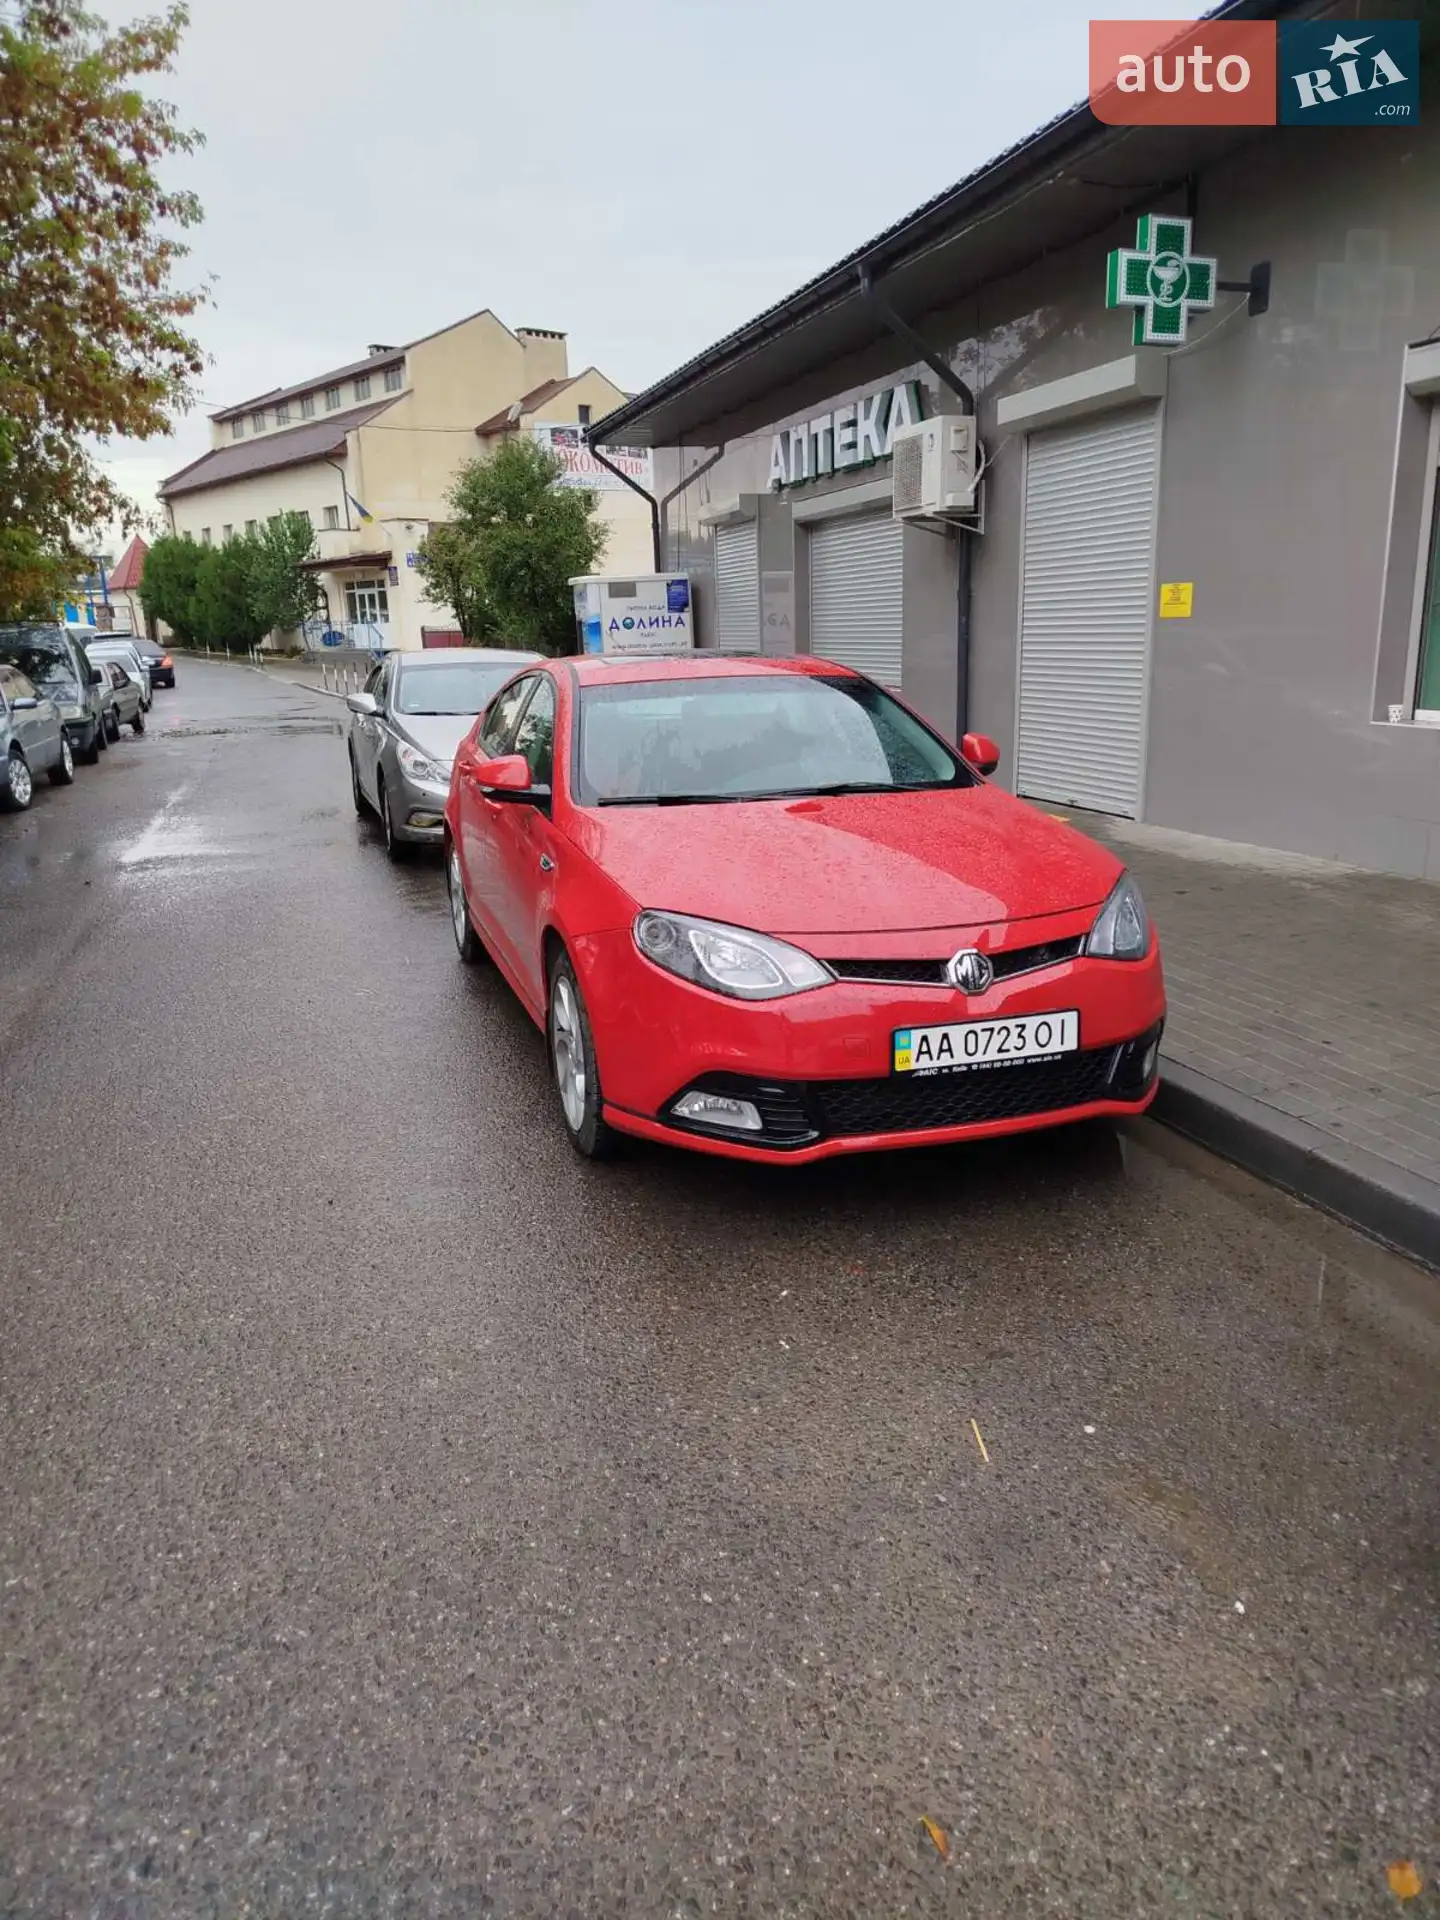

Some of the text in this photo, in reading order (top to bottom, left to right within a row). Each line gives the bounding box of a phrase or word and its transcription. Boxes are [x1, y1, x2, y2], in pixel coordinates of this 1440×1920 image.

[766, 382, 918, 490] АПТЕКА
[609, 615, 685, 632] ДОЛИНА
[955, 954, 990, 990] MG
[915, 1018, 1065, 1064] AA 0723 OI
[898, 1056, 910, 1065] UA
